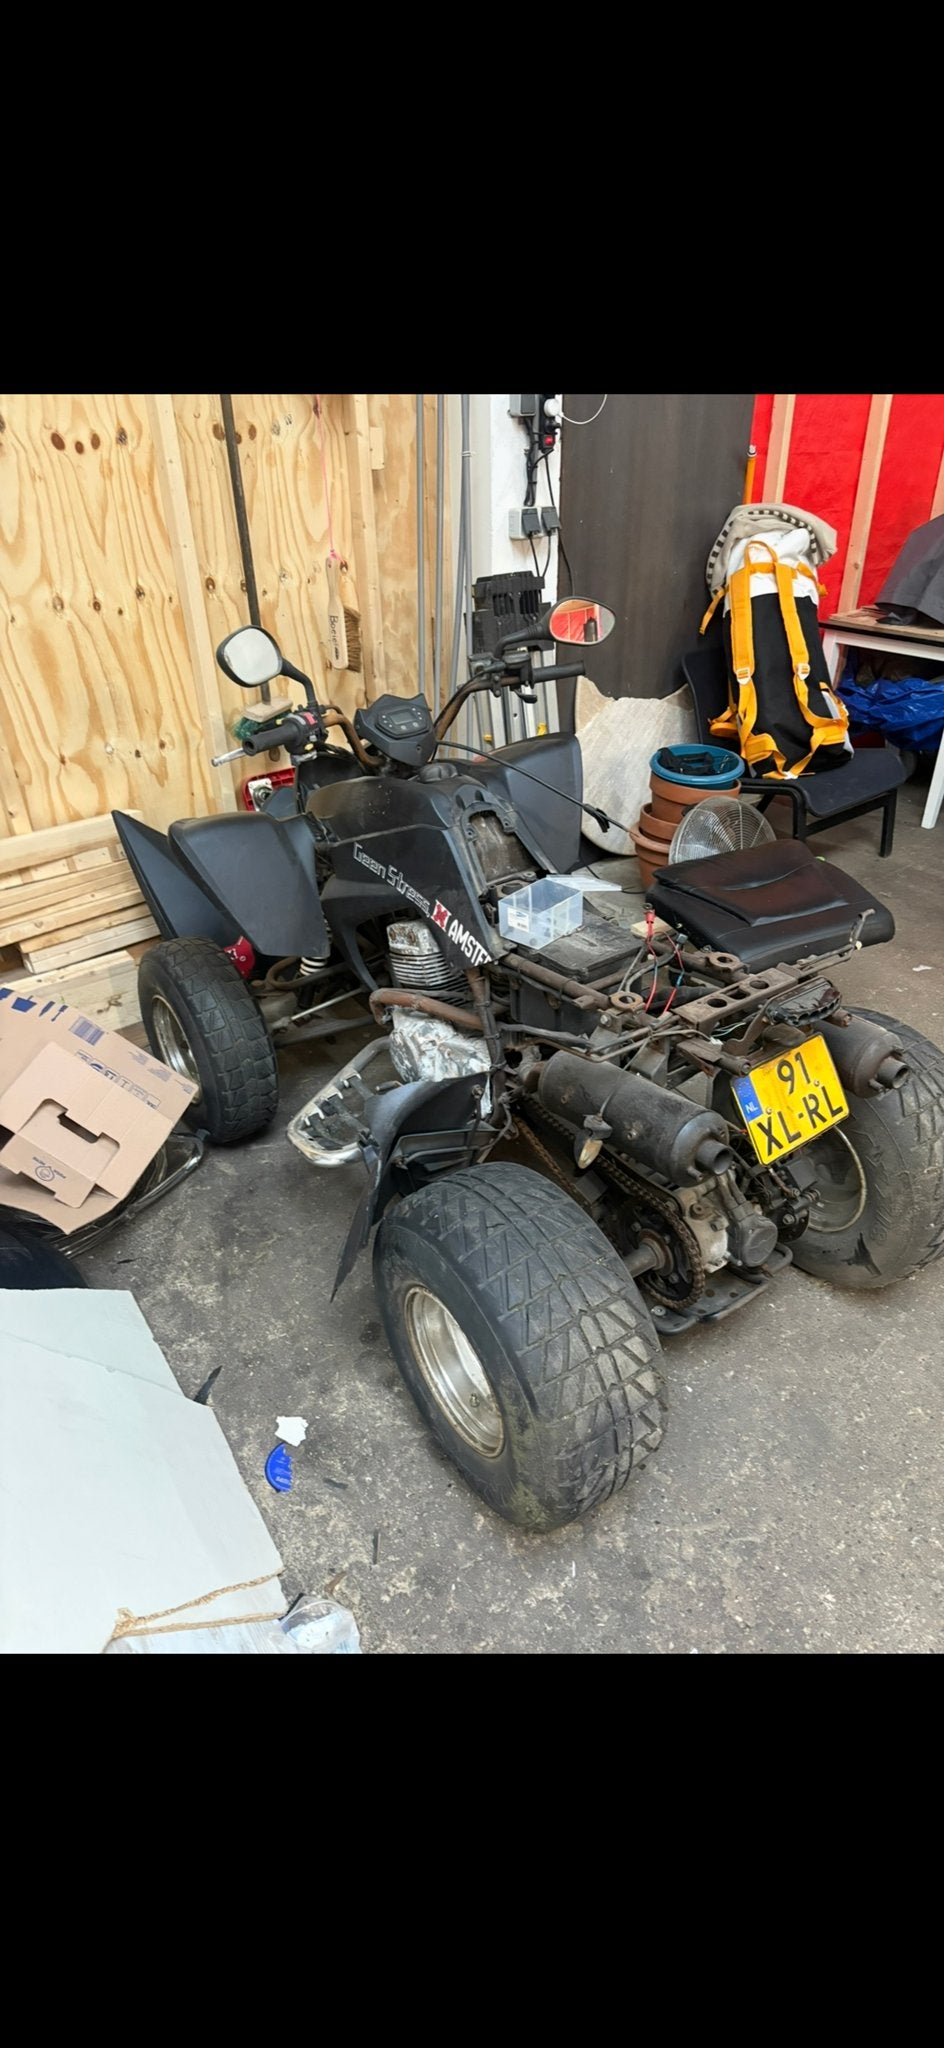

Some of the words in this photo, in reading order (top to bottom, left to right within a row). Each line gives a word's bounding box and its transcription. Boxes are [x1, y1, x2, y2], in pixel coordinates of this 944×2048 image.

[353, 841, 387, 879] Geen
[776, 1051, 812, 1095] 91
[744, 1101, 759, 1115] NL
[756, 1085, 844, 1157] XL-RL
